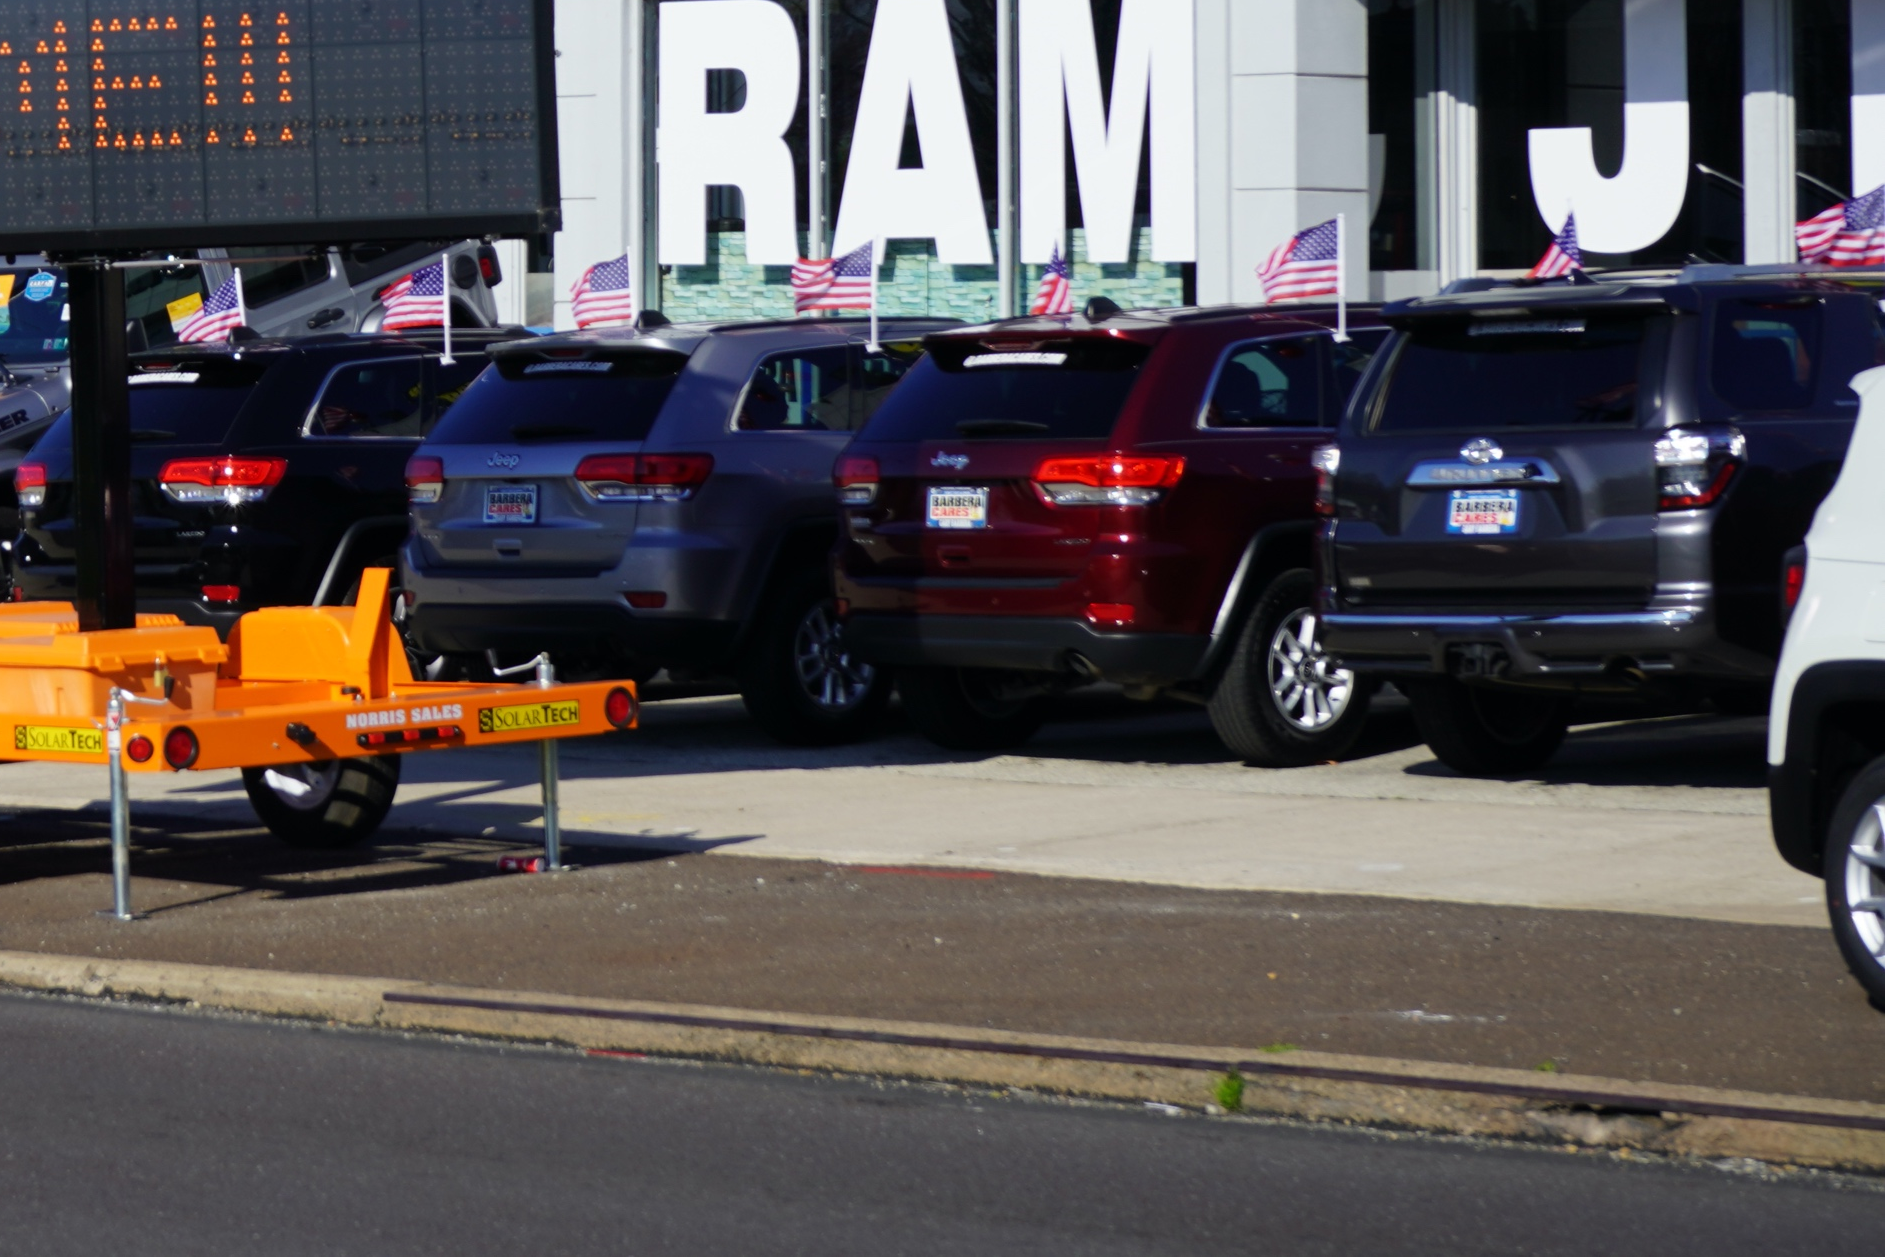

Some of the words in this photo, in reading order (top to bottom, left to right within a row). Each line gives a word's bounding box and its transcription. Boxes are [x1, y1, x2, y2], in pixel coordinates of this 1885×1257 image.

[487, 451, 521, 470] Jeep
[489, 493, 533, 505] BARBERA
[931, 495, 982, 507] BARBERA
[489, 504, 522, 515] CARES
[931, 507, 970, 518] CARES
[346, 708, 407, 730] NORRIS
[410, 703, 463, 723] SALES
